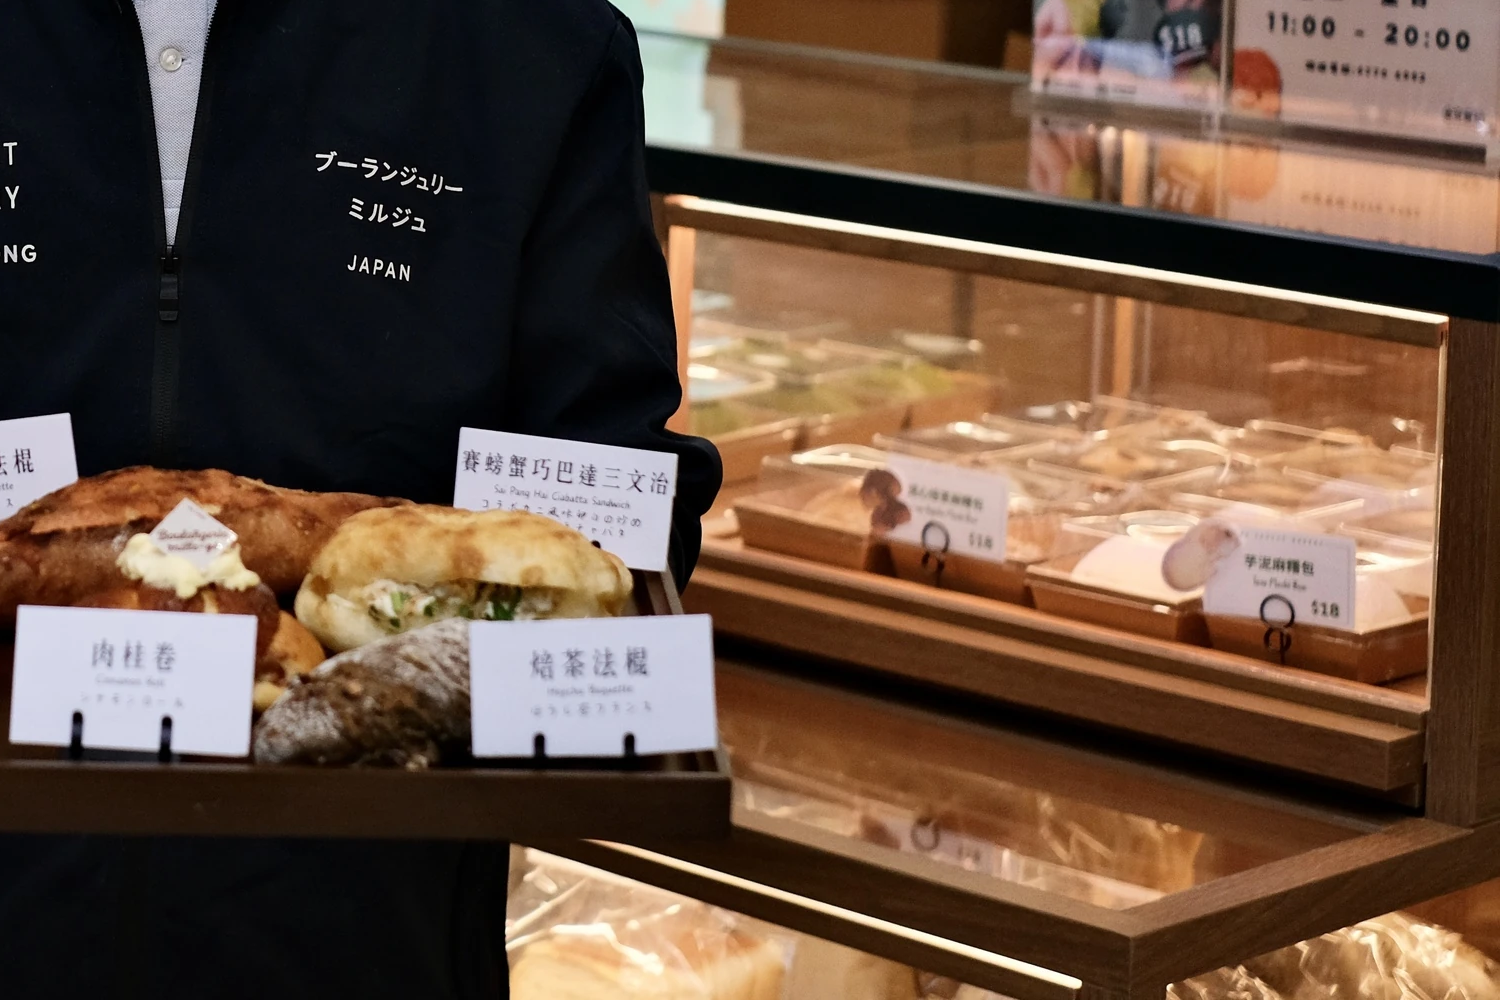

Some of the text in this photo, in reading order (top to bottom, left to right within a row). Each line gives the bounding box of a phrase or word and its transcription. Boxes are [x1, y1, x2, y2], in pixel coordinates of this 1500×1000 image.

[1268, 11, 1336, 38] 11:00
[1384, 22, 1470, 52] 20:00
[315, 151, 464, 199] ブーランジュリー
[348, 198, 427, 234] ミルジュ
[347, 255, 411, 282] JAPAN
[463, 449, 669, 496] 賽螃蟹巧巴達三文治
[510, 486, 530, 499] Pang
[552, 492, 588, 504] Ciabatta
[592, 495, 631, 509] Sandwich
[1311, 600, 1339, 619] $18
[530, 646, 649, 681] 焙茶法棍
